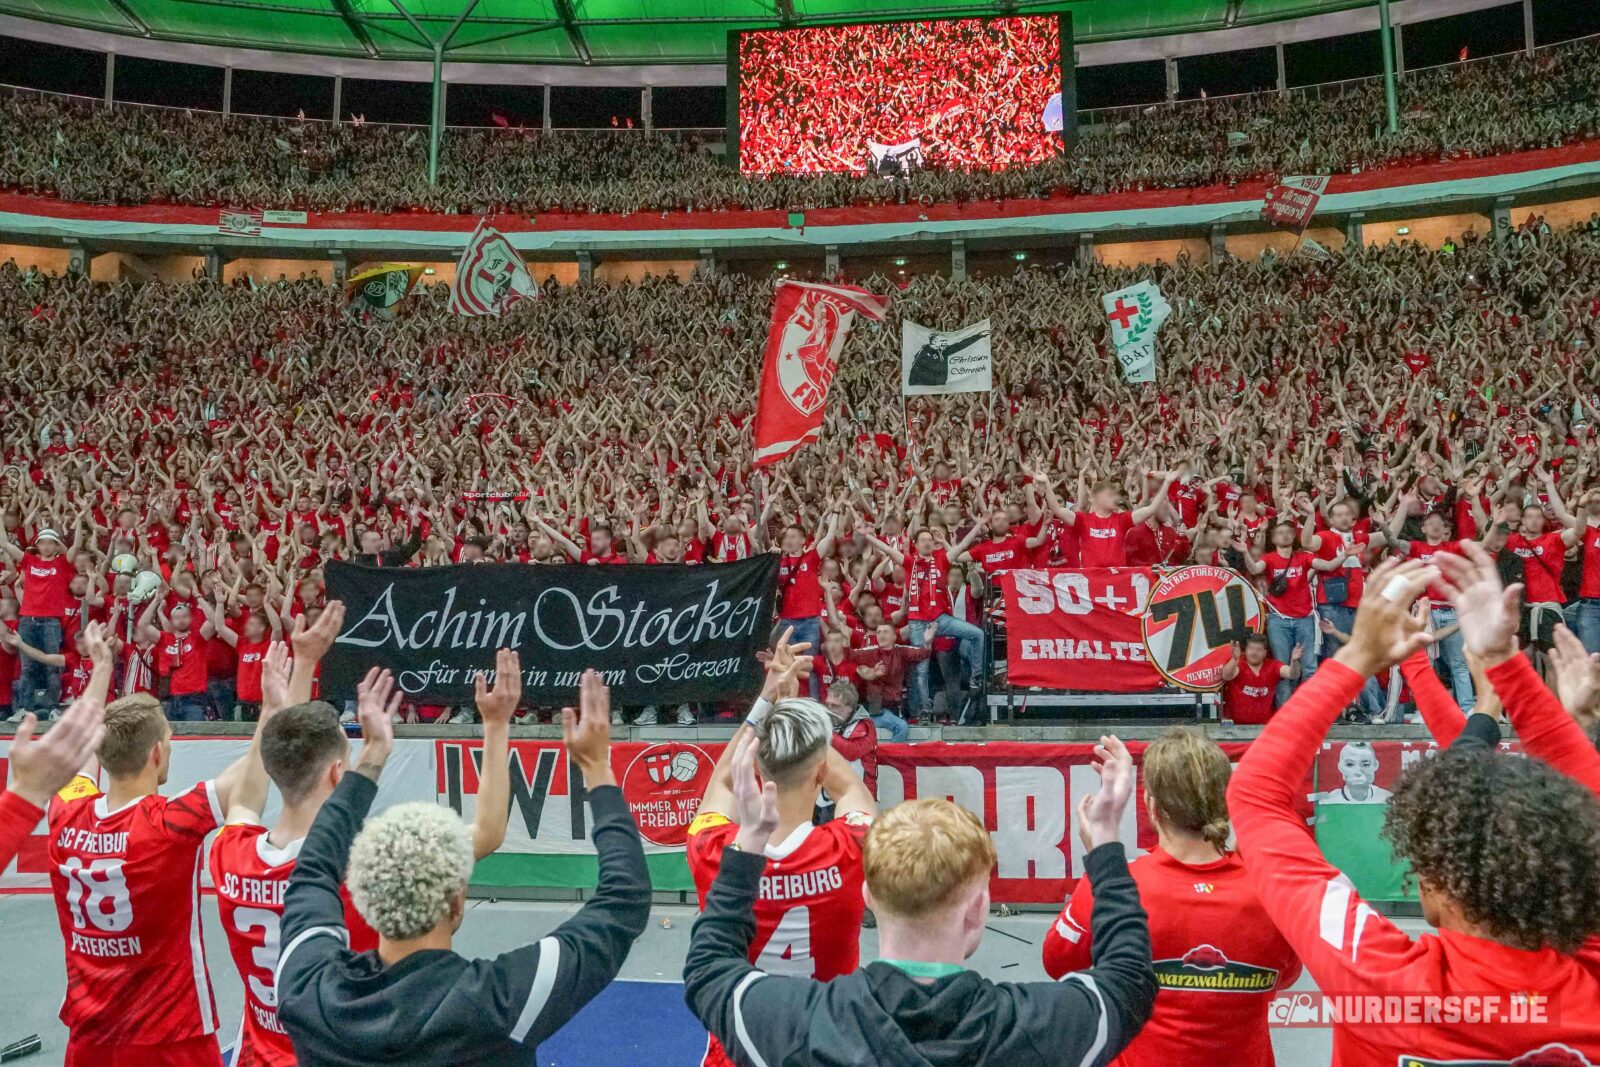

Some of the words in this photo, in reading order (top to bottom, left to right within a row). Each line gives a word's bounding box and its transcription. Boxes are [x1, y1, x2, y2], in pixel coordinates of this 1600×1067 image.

[1159, 571, 1190, 596] ULTRAS
[1190, 567, 1231, 582] FOREVER
[335, 581, 526, 650] Achim
[533, 579, 763, 651] Stocker
[1150, 584, 1255, 672] 74
[1021, 638, 1151, 662] ERHALTE
[399, 659, 459, 694] Für
[526, 665, 548, 687] in
[635, 652, 740, 684] Herzen
[676, 797, 702, 811] WIED
[639, 810, 697, 828] FREIBUR
[57, 826, 76, 849] SC
[58, 856, 134, 932] 18
[219, 872, 240, 899] SC
[759, 865, 843, 900] REIBURG
[71, 931, 142, 957] PETERSEN
[755, 905, 816, 979] 4
